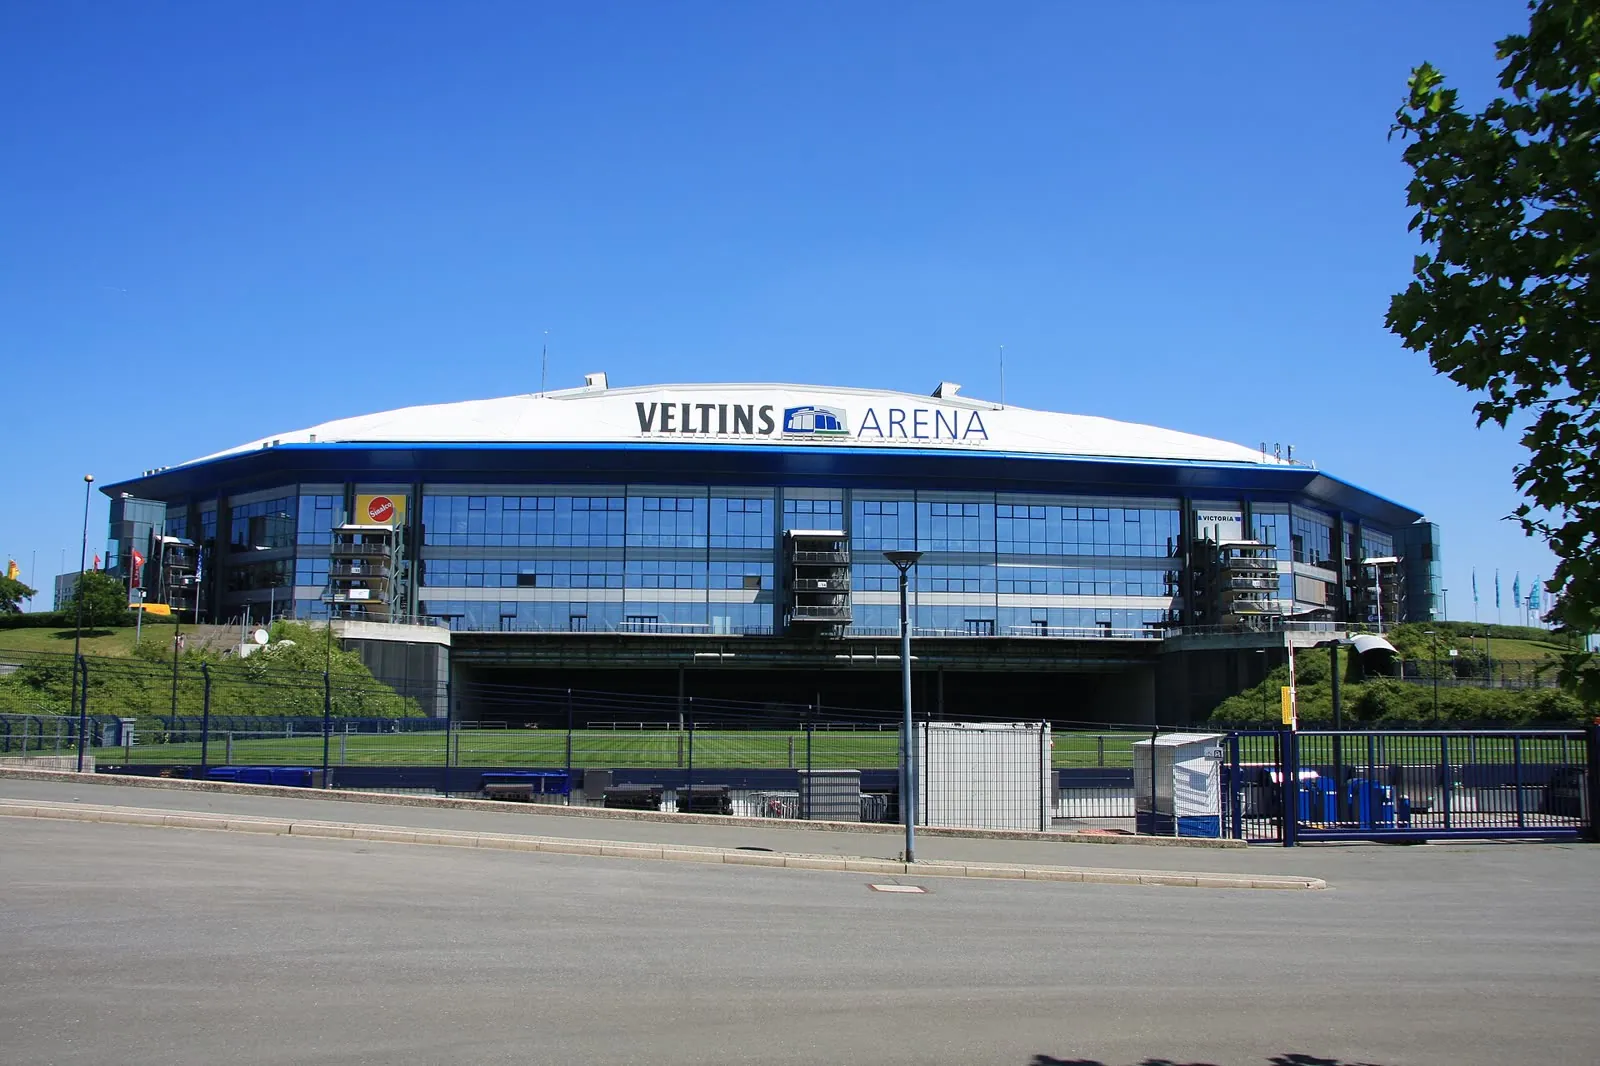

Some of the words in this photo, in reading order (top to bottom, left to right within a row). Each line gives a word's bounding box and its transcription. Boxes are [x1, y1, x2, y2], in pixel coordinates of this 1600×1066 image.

[635, 402, 775, 435] VELTINS
[857, 408, 989, 440] ARENA
[369, 502, 393, 518] Sinalco
